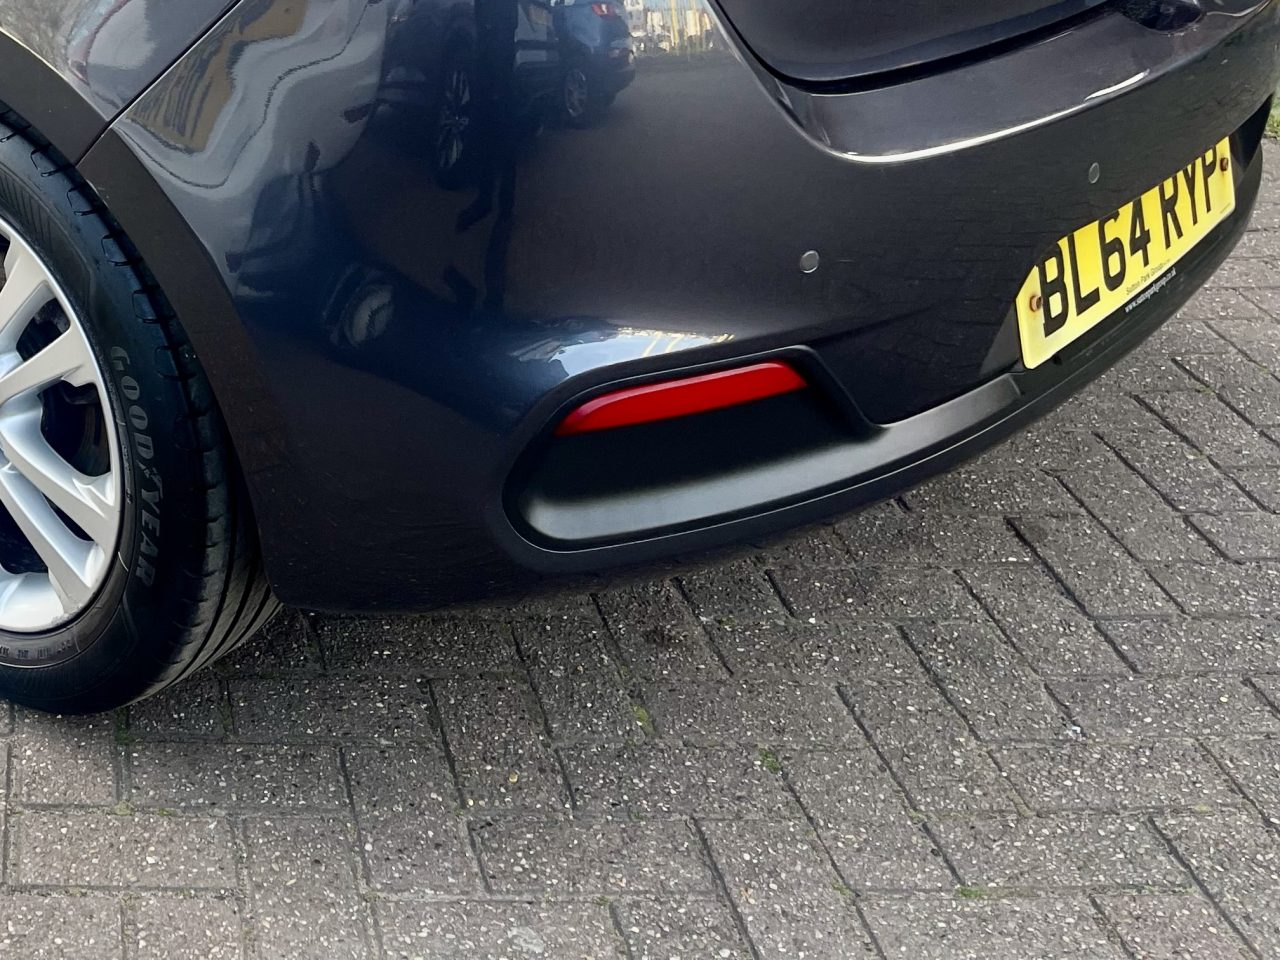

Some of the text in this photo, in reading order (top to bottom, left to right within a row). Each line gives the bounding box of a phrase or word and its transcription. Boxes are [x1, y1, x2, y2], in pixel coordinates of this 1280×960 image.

[1038, 143, 1218, 338] BL64 RYP
[111, 345, 164, 587] GOODYEAR
